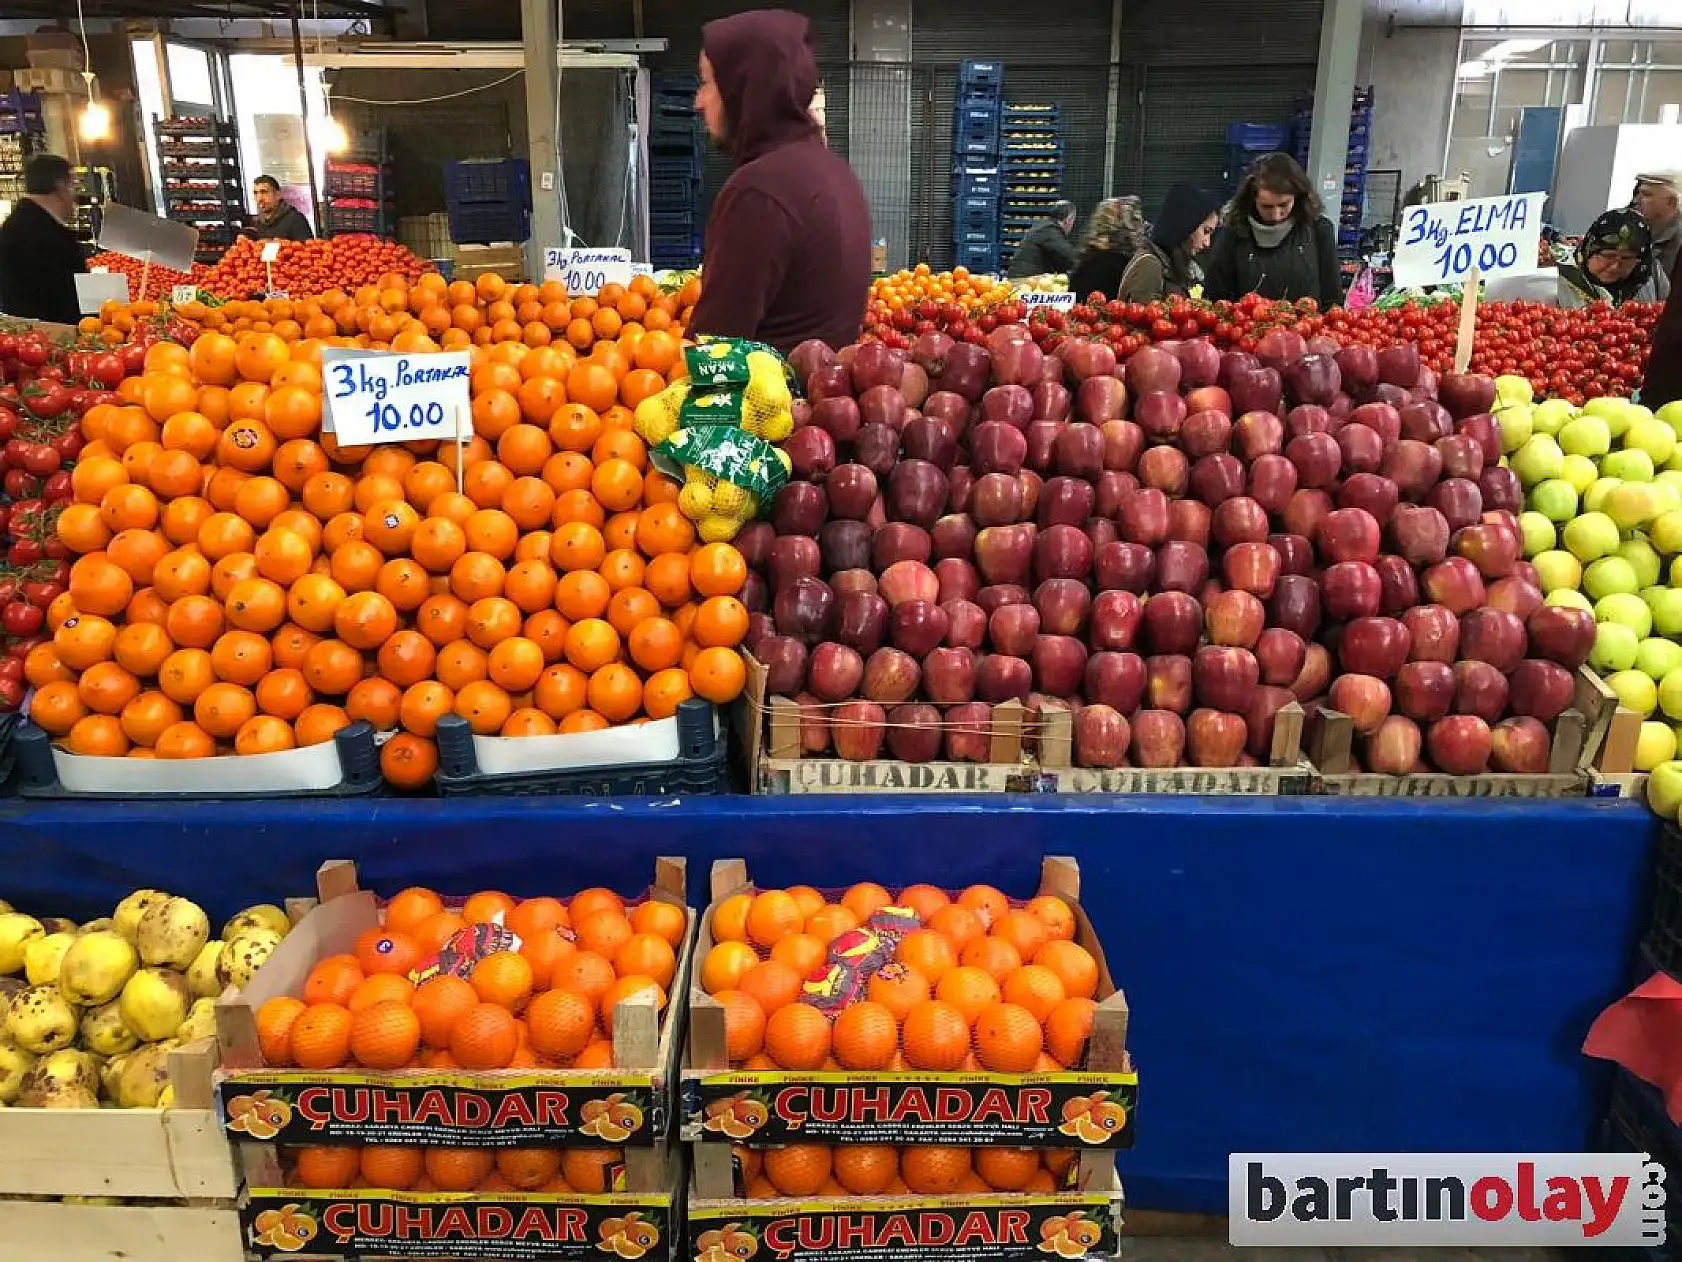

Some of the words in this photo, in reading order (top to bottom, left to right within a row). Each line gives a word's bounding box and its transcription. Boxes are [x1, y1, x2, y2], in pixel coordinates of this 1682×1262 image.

[1455, 199, 1528, 236] ELMA
[366, 401, 444, 434] 10.00
[297, 1086, 570, 1131] ÇUHADAR
[774, 1086, 1052, 1131] ÇUHADAR
[322, 1203, 589, 1244] ÇUHADAR
[765, 1209, 1031, 1260] ÇUHADAR
